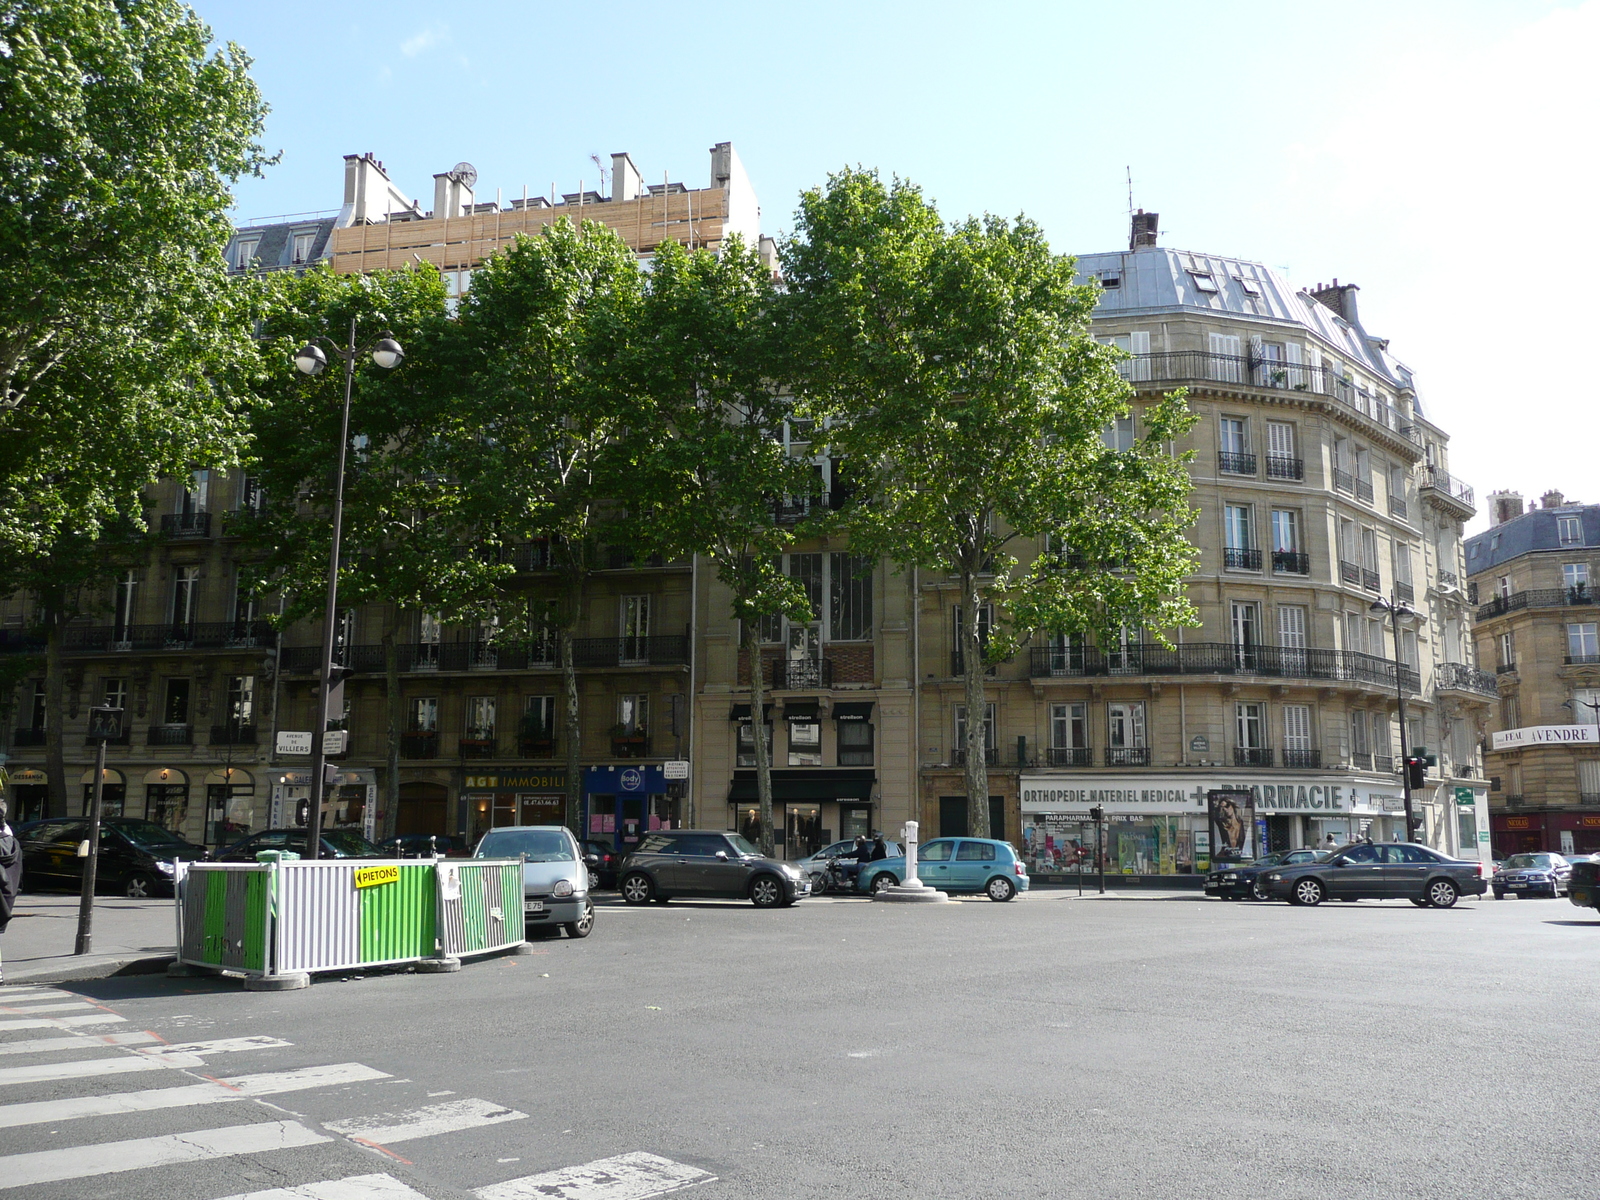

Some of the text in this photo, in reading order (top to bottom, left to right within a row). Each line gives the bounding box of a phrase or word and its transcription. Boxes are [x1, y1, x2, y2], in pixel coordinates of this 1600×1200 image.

[1537, 728, 1589, 741] VENDRE
[465, 776, 565, 787] AGT IMMOBILI
[622, 773, 640, 783] Body
[1024, 789, 1187, 802] ORTHOPEDIE MATERIEL MEDICAL
[1221, 784, 1343, 810] ARMACIE
[366, 787, 375, 840] SCULPTURES
[1045, 814, 1096, 822] PARAPHARMAC
[1507, 819, 1528, 827] NICOLAS
[362, 867, 398, 882] PIETONS
[533, 902, 542, 910] 75
